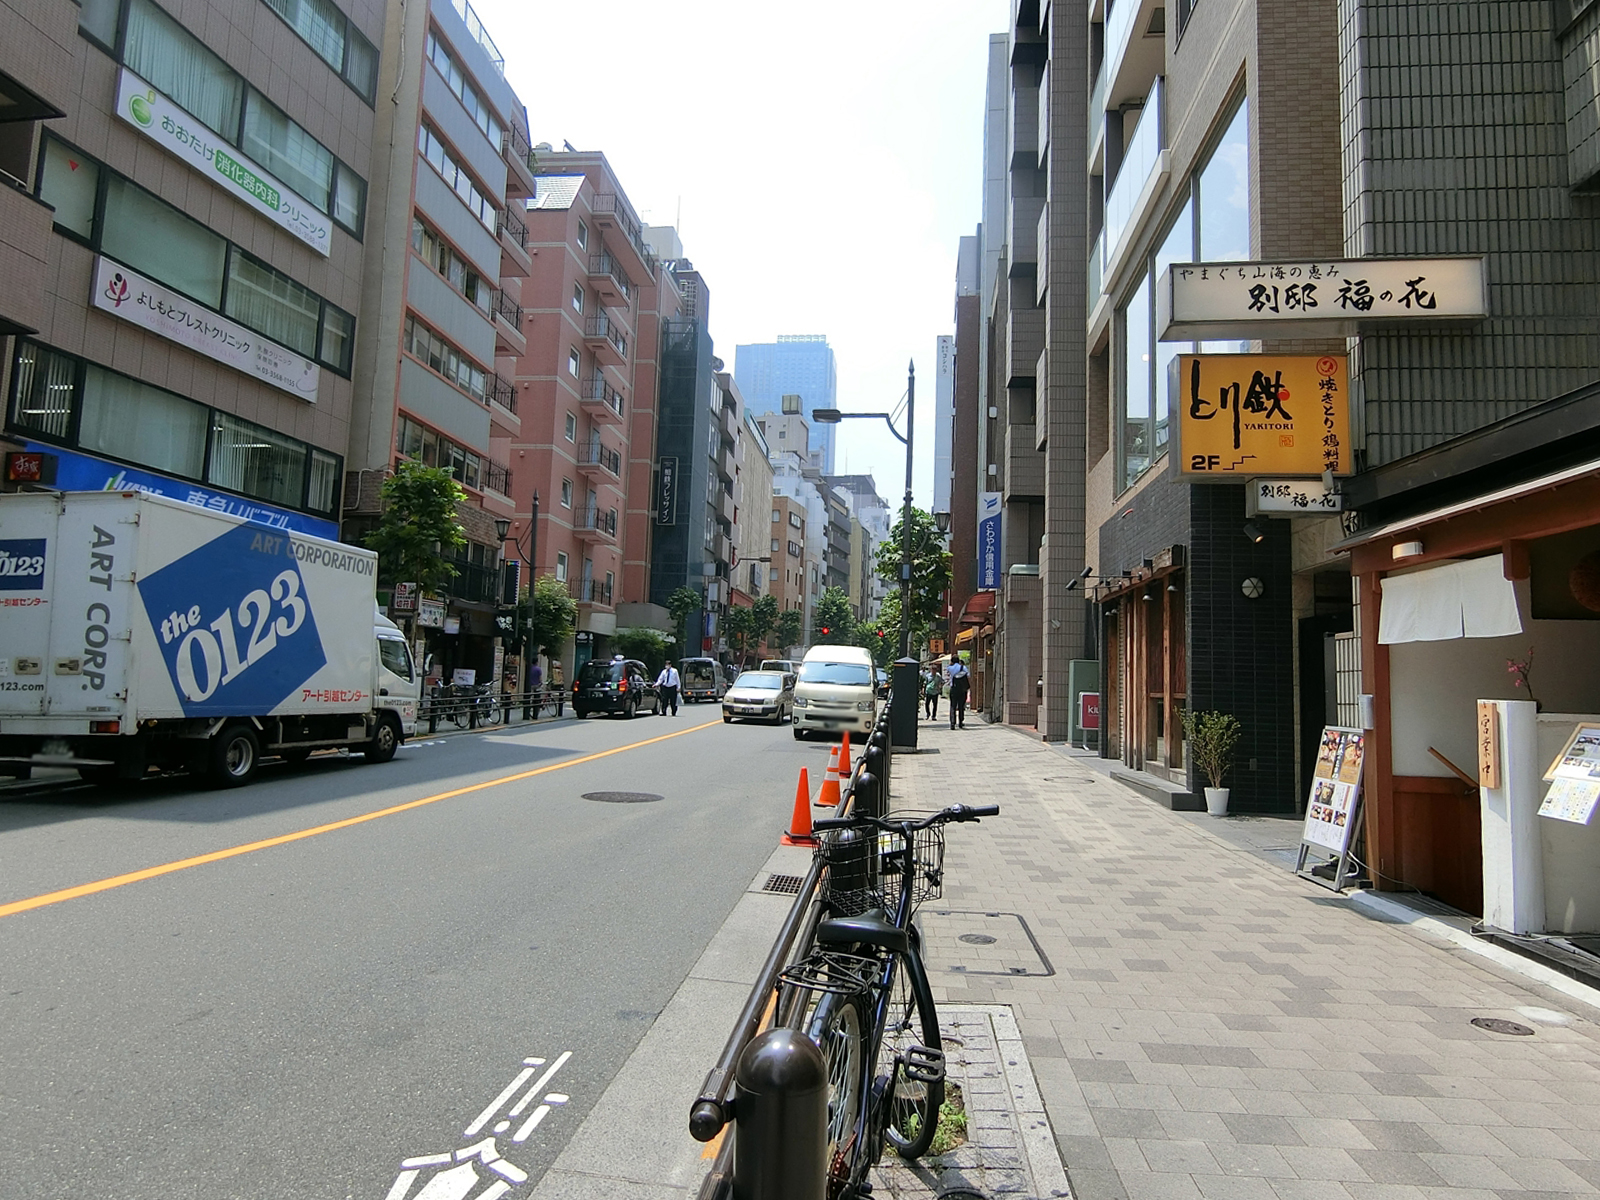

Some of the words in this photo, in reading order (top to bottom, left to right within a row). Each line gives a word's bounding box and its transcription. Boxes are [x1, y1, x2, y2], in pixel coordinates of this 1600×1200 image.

[1248, 283, 1319, 313] 別邸
[1333, 278, 1437, 311] 福の花
[137, 292, 250, 353] よしもとブレストクリニック
[1191, 454, 1220, 470] 2F
[1260, 484, 1291, 498] 別邸
[1291, 492, 1336, 508] 福の花
[89, 525, 115, 591] ART
[250, 532, 283, 556] ART
[286, 540, 374, 577] CORPORATION
[160, 604, 201, 644] the
[176, 569, 306, 702] 0123
[81, 602, 111, 691] CORP.
[302, 690, 369, 702] アート引越センター
